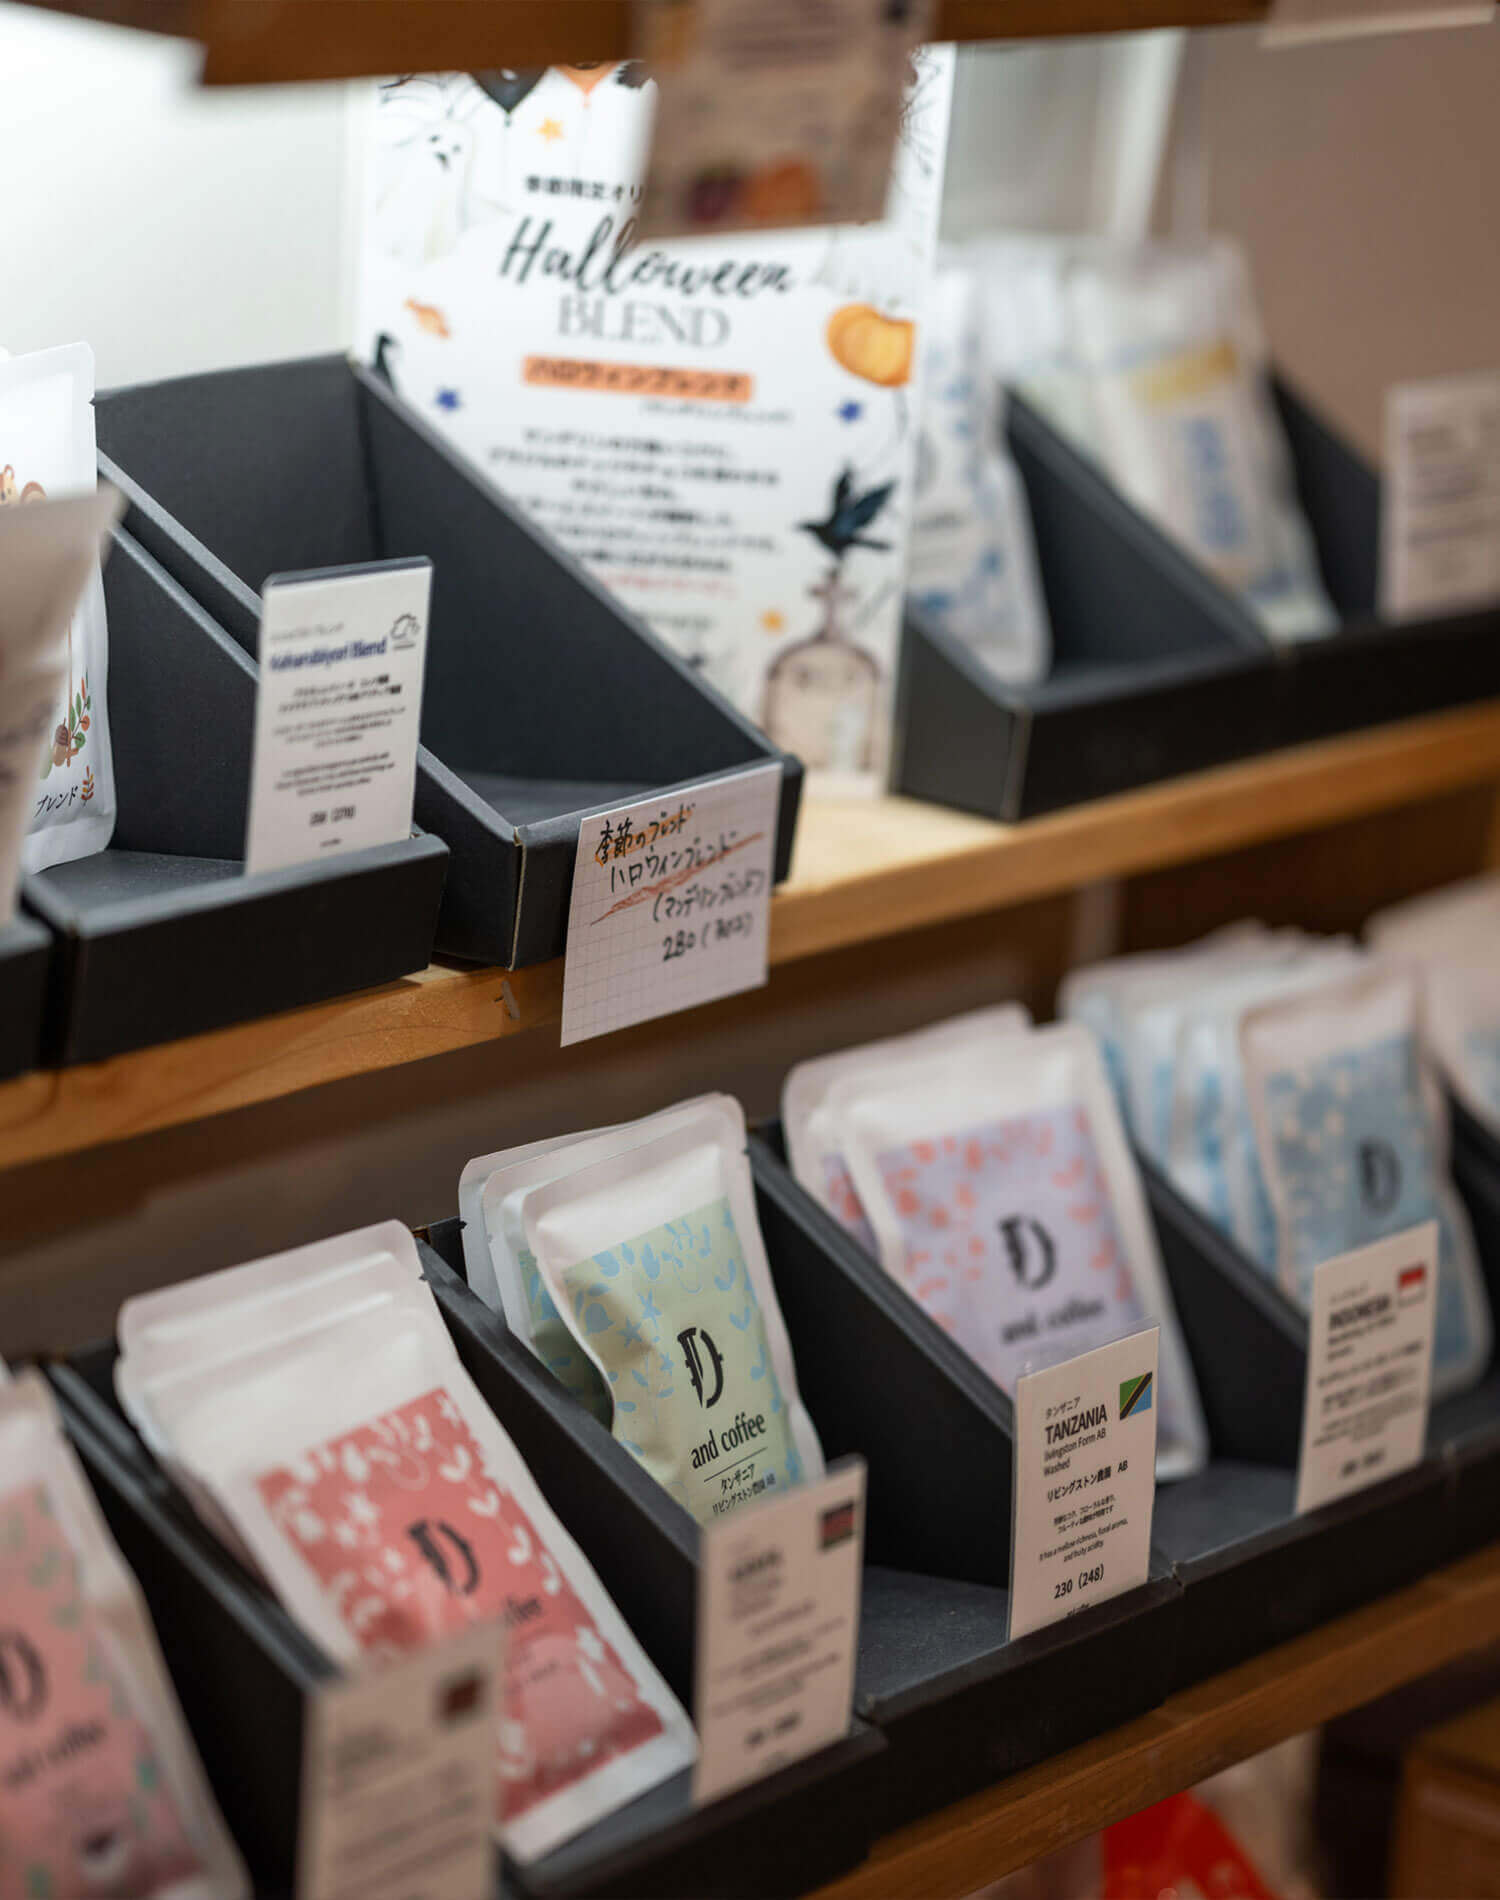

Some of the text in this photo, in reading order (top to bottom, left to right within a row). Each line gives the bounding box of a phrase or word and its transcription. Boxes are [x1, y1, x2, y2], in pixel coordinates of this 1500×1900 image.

[499, 214, 791, 297] Halloween
[558, 294, 732, 350] BLEND
[677, 1327, 724, 1409] D
[690, 1411, 767, 1469] and coffee
[1044, 1403, 1108, 1446] TANZANIA
[1096, 1427, 1107, 1440] AB
[721, 1463, 755, 1495] タンザニア
[1117, 1459, 1129, 1473] AB
[1053, 1563, 1104, 1600] 230 (248)
